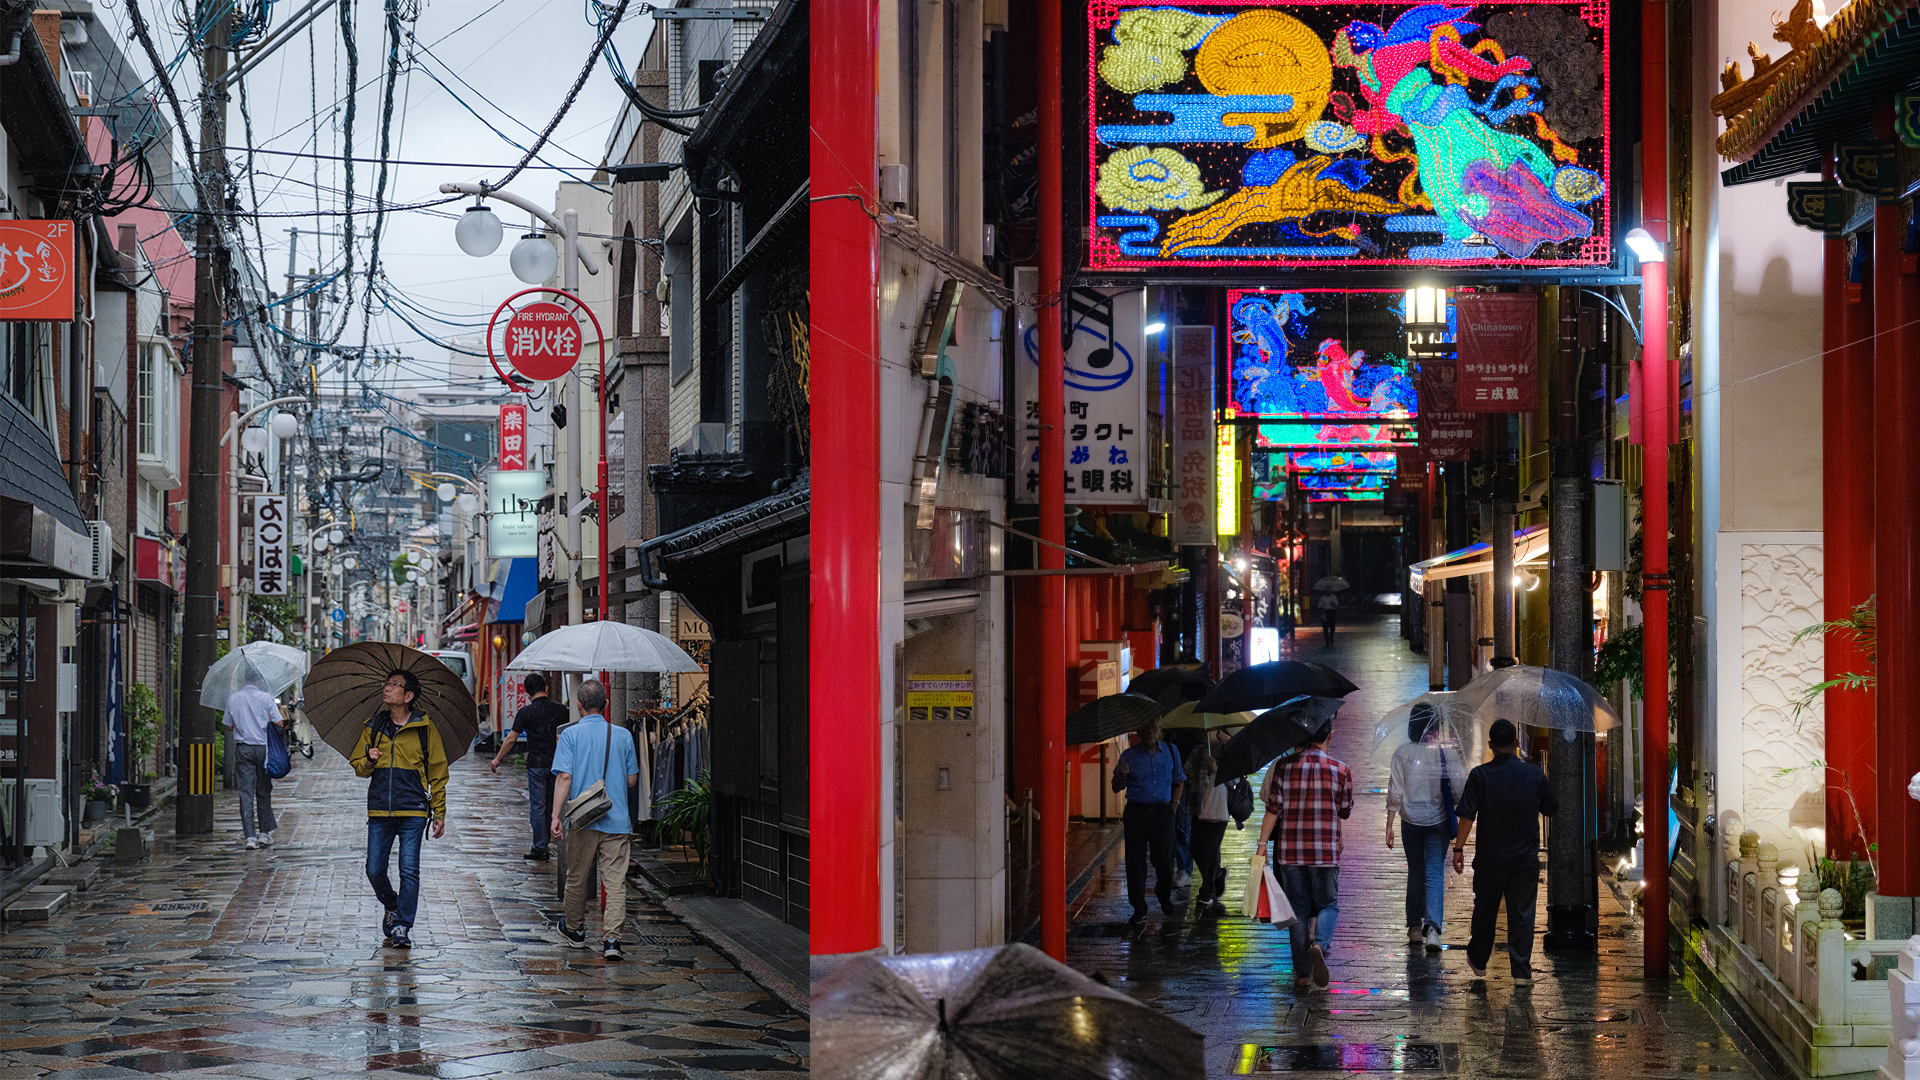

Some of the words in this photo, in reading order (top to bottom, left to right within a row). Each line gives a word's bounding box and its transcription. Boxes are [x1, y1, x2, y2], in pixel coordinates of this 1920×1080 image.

[47, 223, 68, 237] 2F
[517, 312, 534, 322] FIRE
[535, 312, 570, 322] HYDRANT
[1470, 323, 1522, 331] Chinatown
[511, 326, 577, 357] 消火栓
[1475, 387, 1519, 400] 三成號
[259, 498, 283, 593] よこはま
[506, 675, 515, 719] 人形ケース
